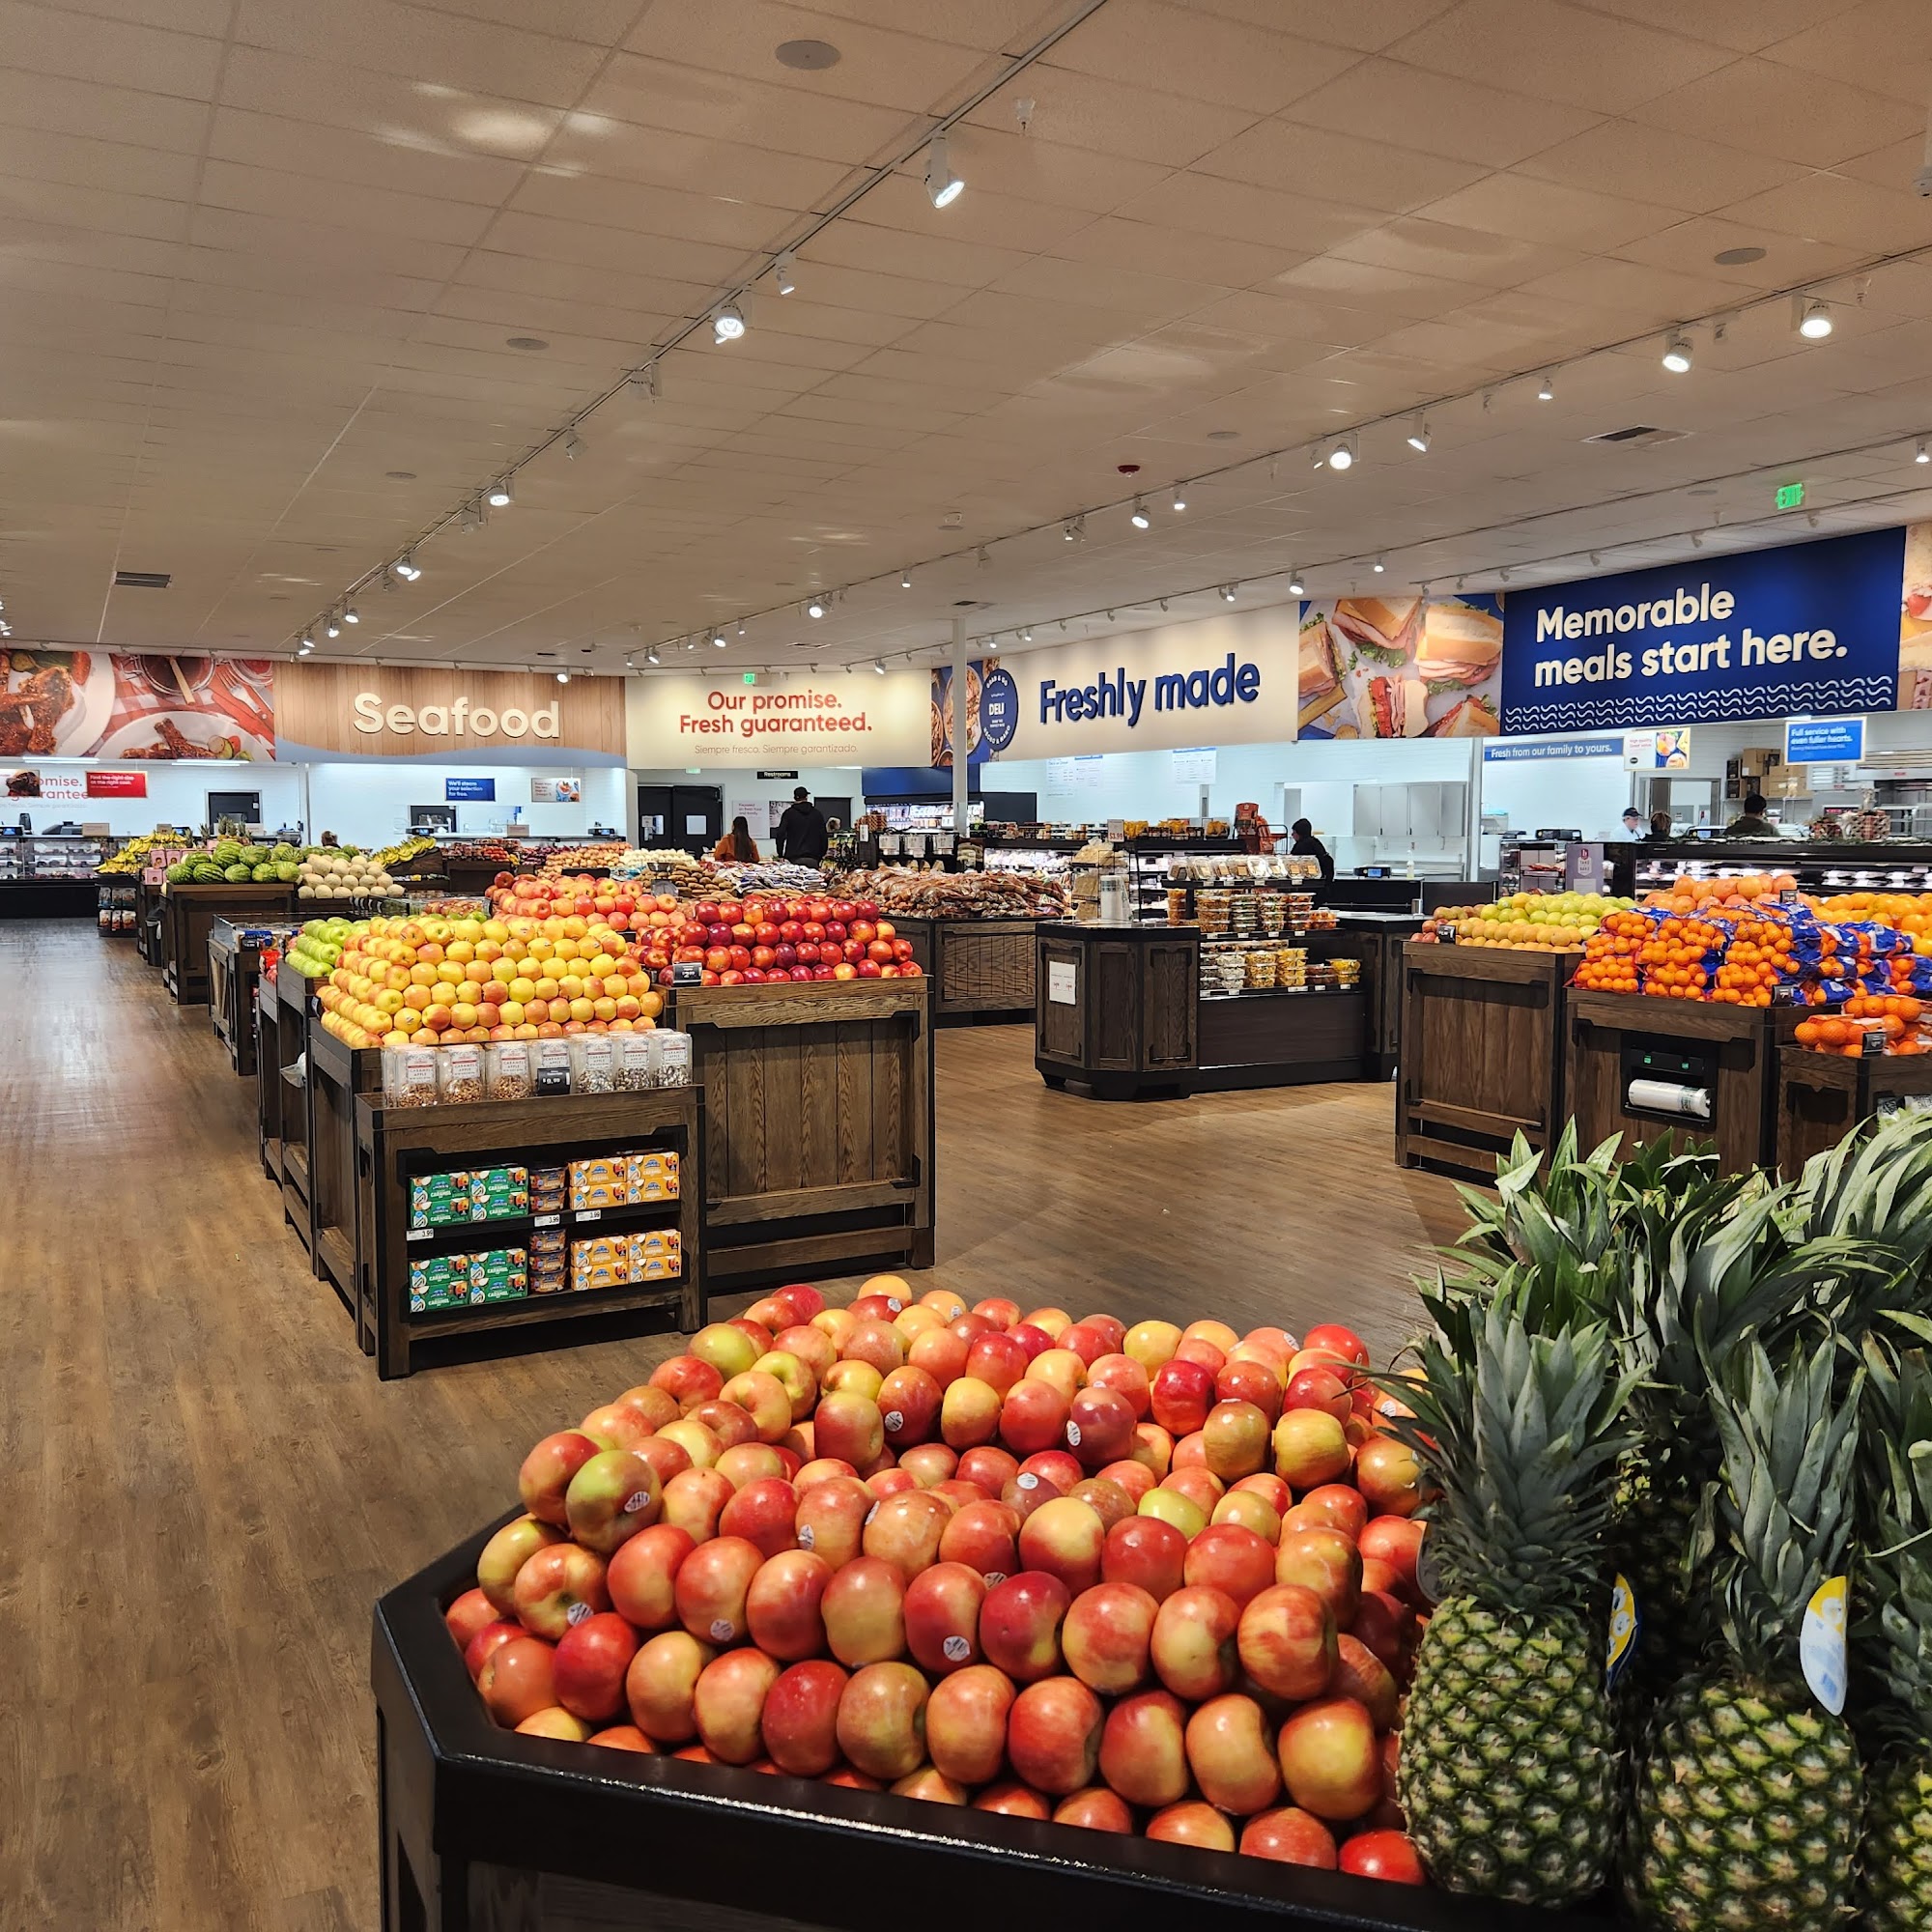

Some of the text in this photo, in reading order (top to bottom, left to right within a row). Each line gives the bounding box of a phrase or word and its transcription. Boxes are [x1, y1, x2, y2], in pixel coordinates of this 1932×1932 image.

[1536, 583, 1735, 642] Memorable
[1534, 628, 1847, 687] meals start here.
[708, 689, 842, 714] Our promise.
[1040, 653, 1260, 727] Freshly made
[354, 693, 560, 738] Seafood
[989, 702, 1004, 715] DELI
[680, 712, 872, 738] Fresh guaranteed.
[695, 744, 858, 755] Siempre fresco. Siempre garantizado.
[1491, 744, 1612, 758] Fresh from our family to yours.
[40, 775, 82, 786] omise.
